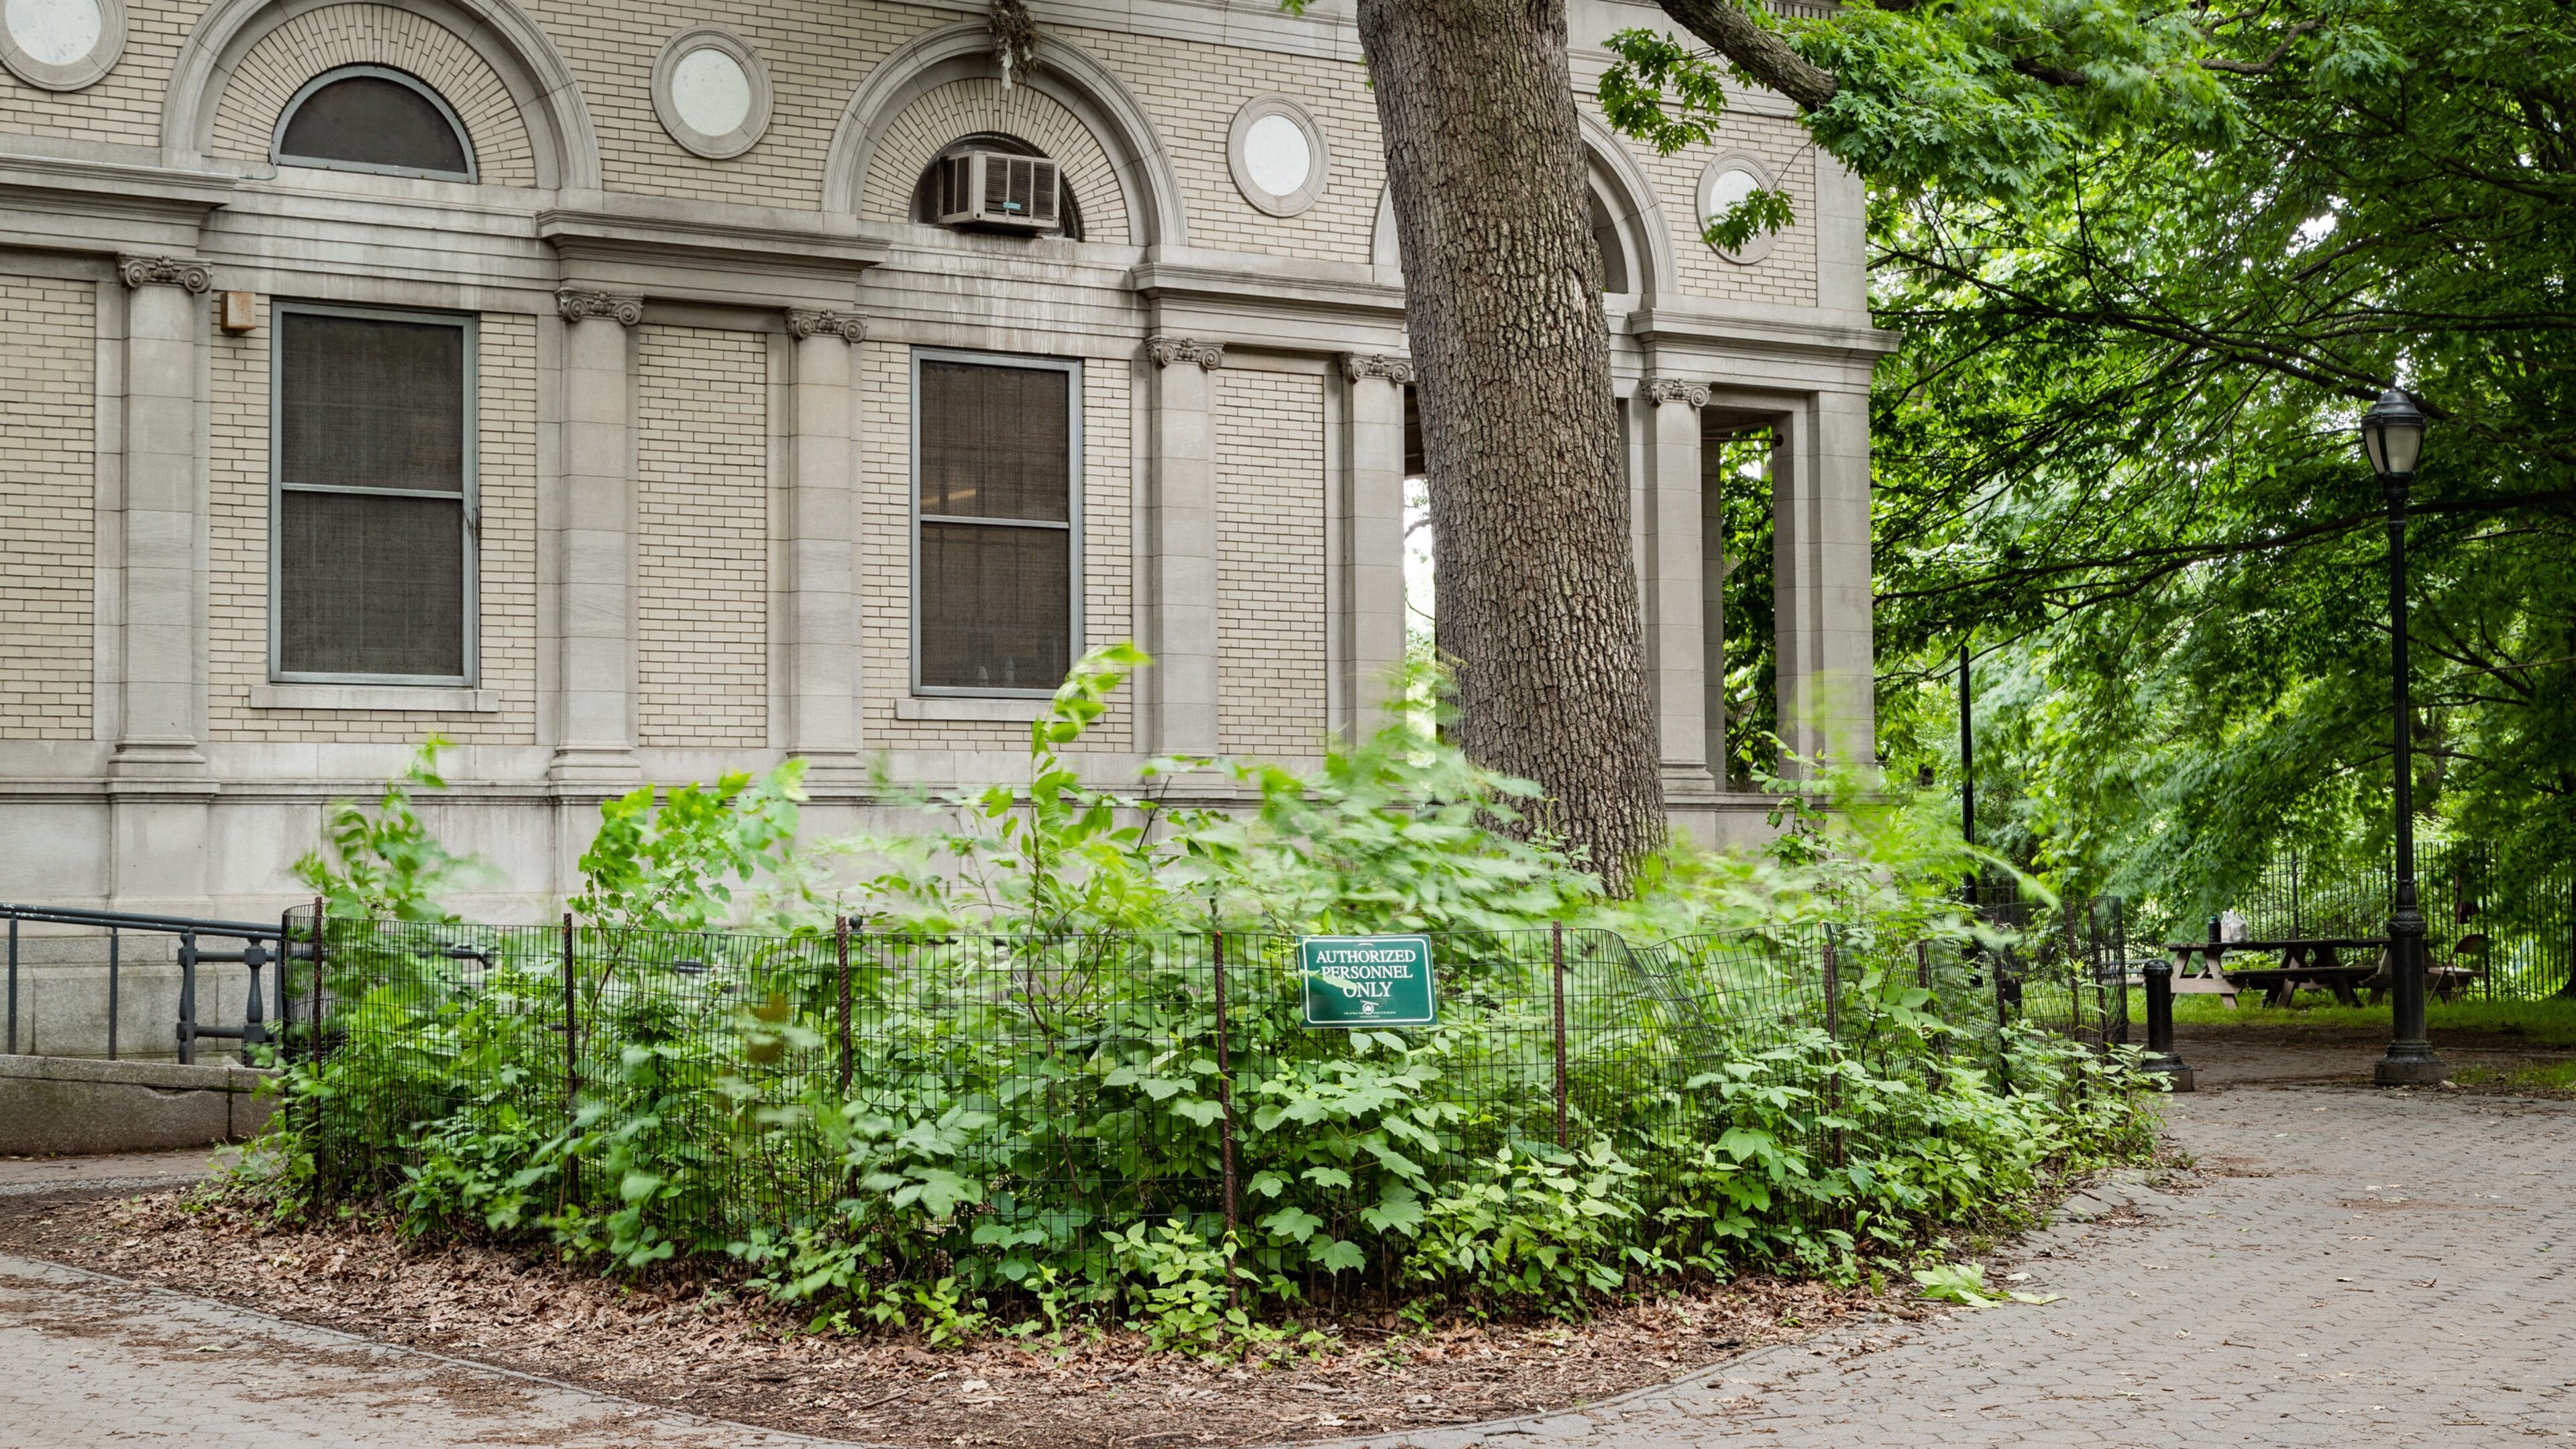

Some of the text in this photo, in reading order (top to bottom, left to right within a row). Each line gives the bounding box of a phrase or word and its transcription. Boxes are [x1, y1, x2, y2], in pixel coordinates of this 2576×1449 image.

[1316, 949, 1416, 963] AUTHORIZED
[1321, 965, 1413, 979] PERSONNEL
[1343, 981, 1393, 998] ONLY
